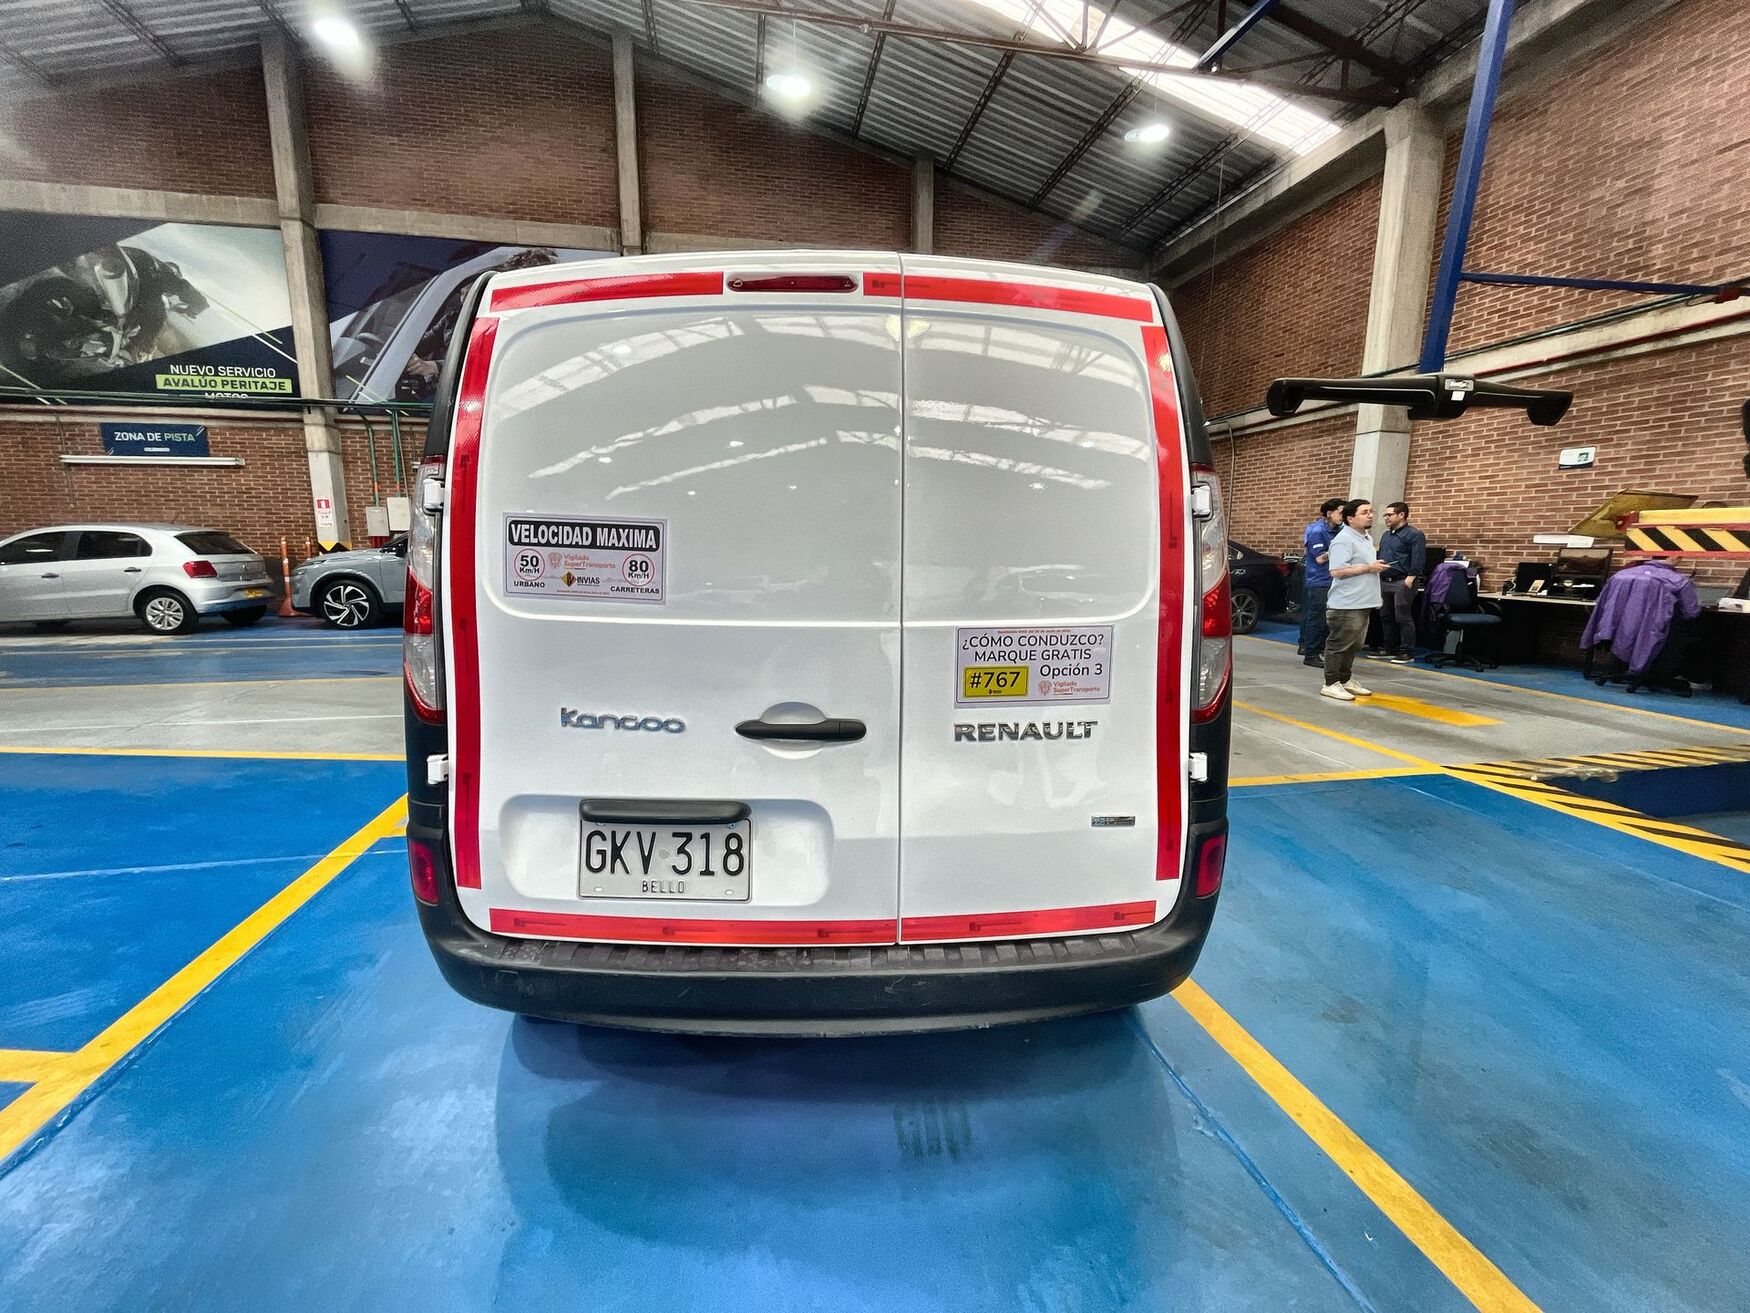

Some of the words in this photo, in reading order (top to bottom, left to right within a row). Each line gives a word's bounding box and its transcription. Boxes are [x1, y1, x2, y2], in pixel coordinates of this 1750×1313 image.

[170, 364, 215, 376] NUEVO
[218, 366, 276, 378] SERVICIO
[163, 376, 218, 388] AVALÚO
[221, 379, 287, 391] PERITAJE
[114, 431, 145, 441] ZONA
[147, 432, 162, 441] DE
[164, 432, 195, 442] PISTA
[511, 523, 592, 546] VELOCIDAD
[596, 528, 657, 549] MAXIMA
[520, 554, 540, 568] 50
[564, 553, 589, 562] Vigilado
[519, 566, 540, 574] Km/H
[628, 559, 649, 572] 80
[513, 580, 546, 588] URBANO
[577, 576, 600, 584] INVIAS
[610, 585, 660, 594] CARRETERAS
[962, 632, 1013, 651] ¿CÓMO
[1018, 633, 1105, 647] CONDUZCO?
[974, 650, 1037, 664] MARQUE
[1041, 648, 1092, 661] GRATIS
[1040, 662, 1090, 680] Opción
[1094, 663, 1103, 676] 3
[970, 671, 1021, 688] #767
[1053, 680, 1078, 688] Vigilado
[1053, 686, 1101, 694] SuperTransporte
[954, 720, 1098, 742] RENAULT
[585, 830, 656, 875] GKV
[671, 831, 745, 877] 318
[641, 880, 685, 894] BELLO
